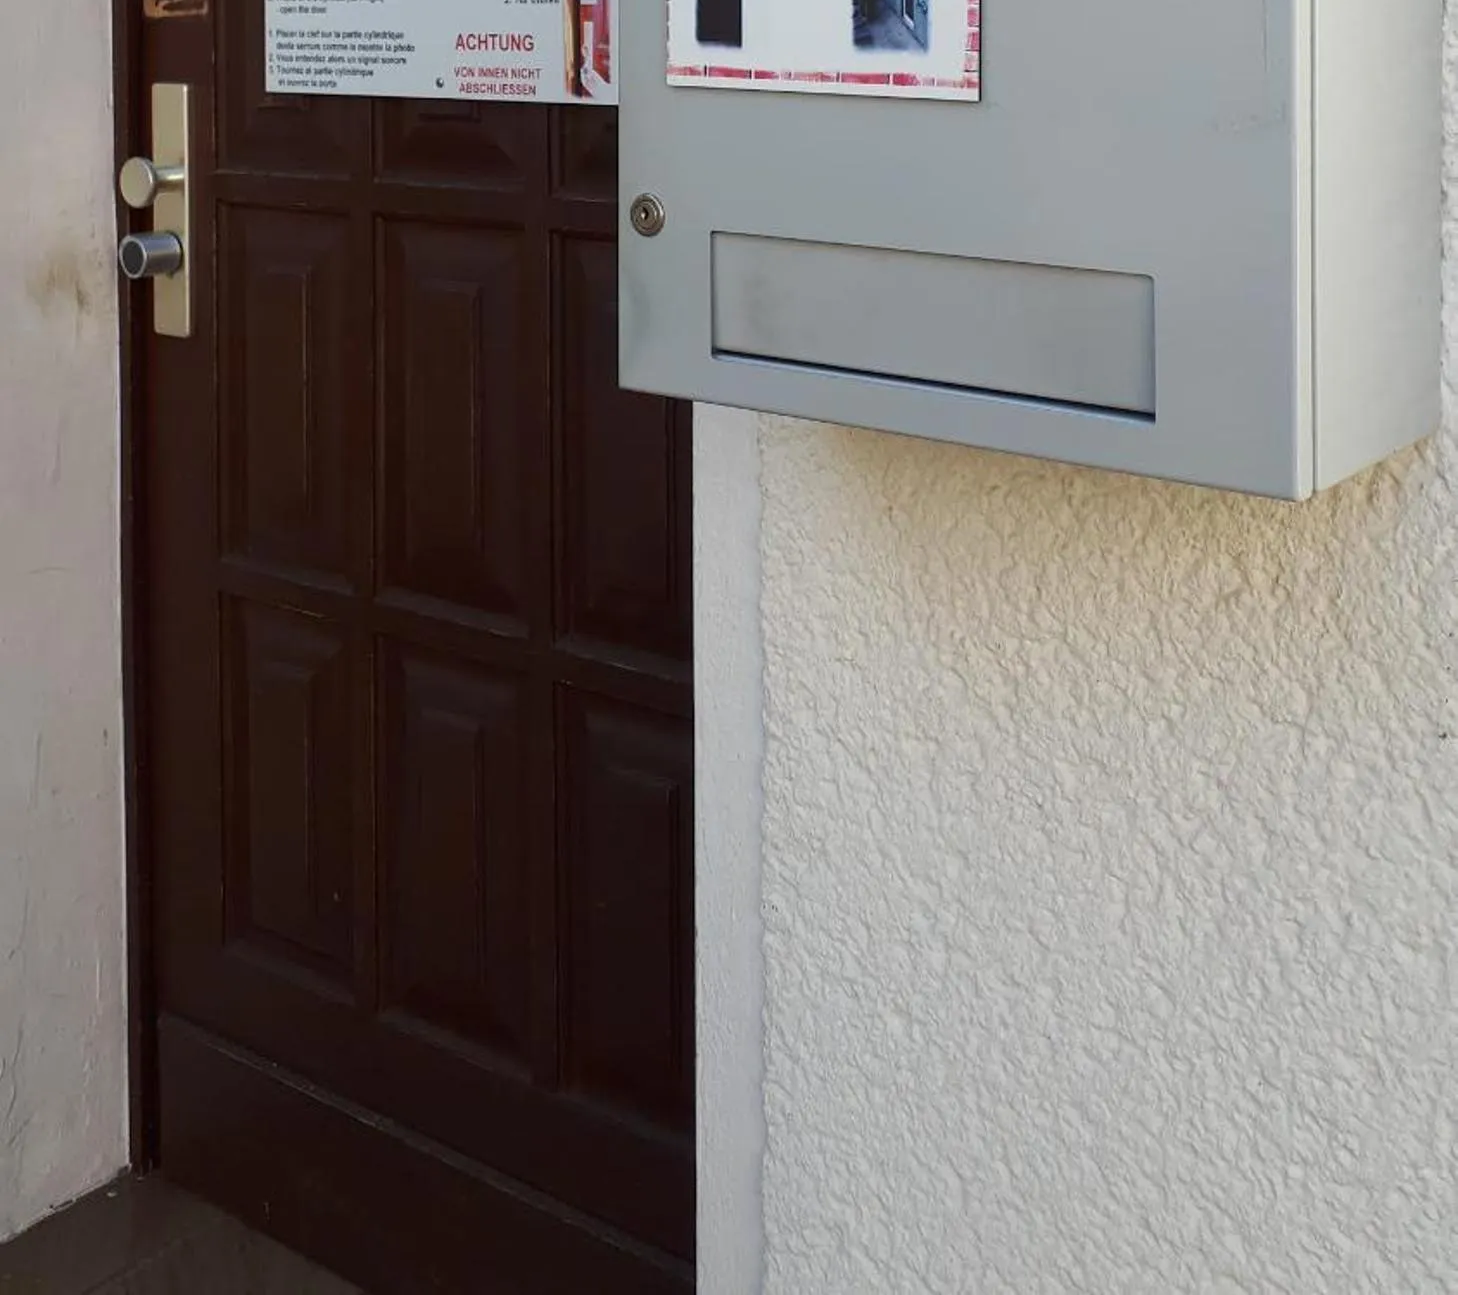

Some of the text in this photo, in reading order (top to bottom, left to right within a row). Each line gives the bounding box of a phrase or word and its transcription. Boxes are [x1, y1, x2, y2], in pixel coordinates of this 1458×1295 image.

[455, 33, 535, 52] ACHTUNG
[454, 67, 543, 79] VON INNEN NICHT
[459, 83, 537, 96] ABSCHLIESSEN
